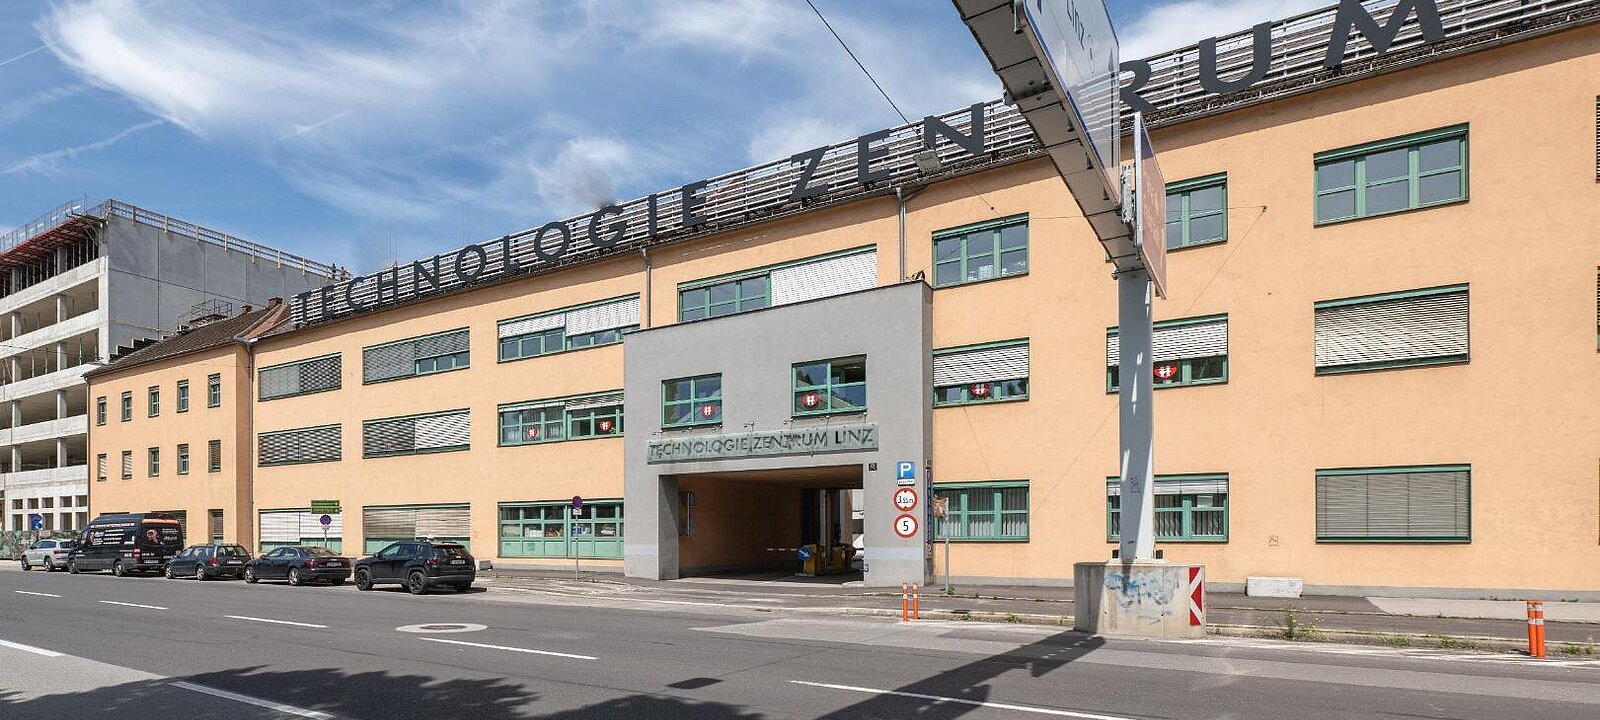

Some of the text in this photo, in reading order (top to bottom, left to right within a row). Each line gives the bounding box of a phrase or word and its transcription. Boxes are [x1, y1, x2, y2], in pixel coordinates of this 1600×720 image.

[298, 0, 1445, 324] TECHNOLOGIE ZENRUM
[649, 428, 874, 459] TECHNOLOGIE ZENTRUM LINZ
[900, 462, 912, 478] P
[903, 520, 909, 532] 5
